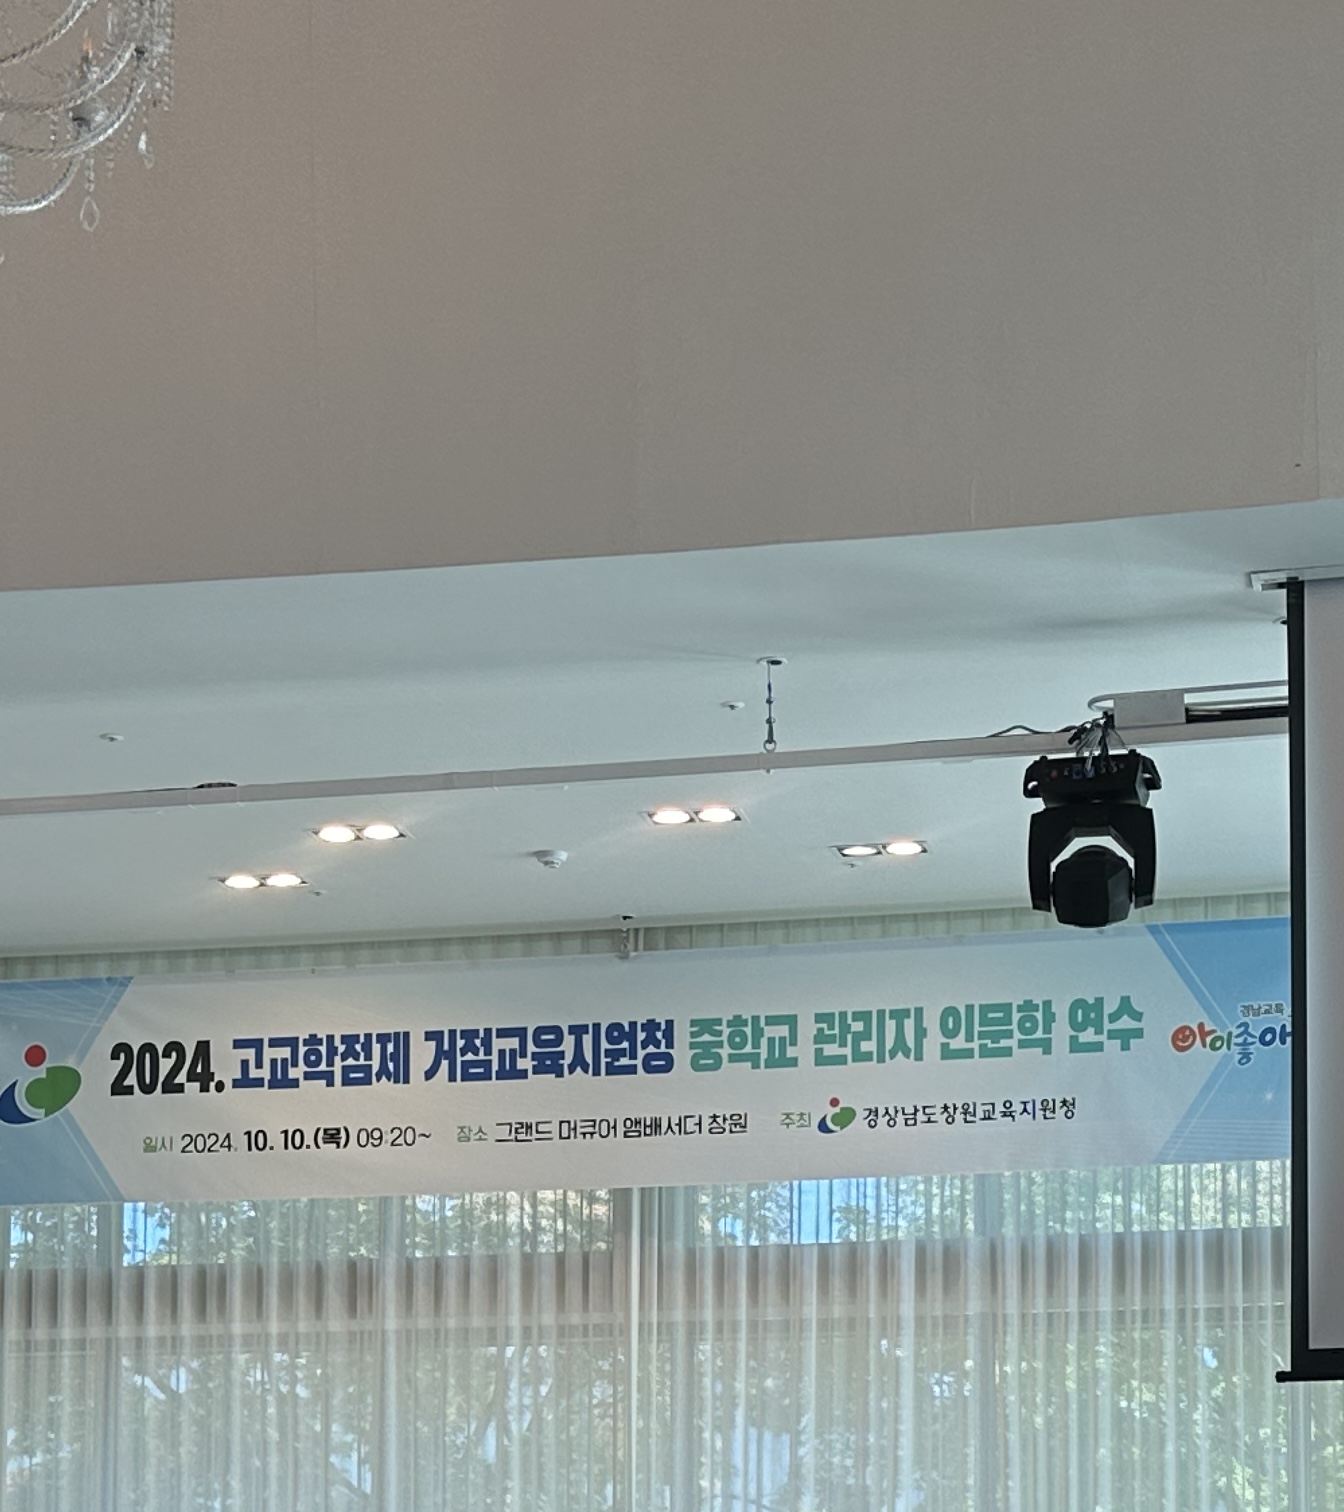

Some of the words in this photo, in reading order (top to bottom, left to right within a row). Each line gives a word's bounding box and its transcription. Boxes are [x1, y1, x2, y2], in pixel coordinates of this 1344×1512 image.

[109, 1039, 226, 1097] 2024.
[231, 1031, 411, 1090] 고교학점제
[423, 1018, 675, 1083] 거점교육지원청
[689, 1014, 799, 1073] 중학교
[813, 1005, 927, 1067] 관리자
[939, 999, 1056, 1061] 인문학
[1067, 995, 1145, 1054] 연수
[142, 1135, 174, 1154] 일시
[180, 1132, 238, 1154] 2024.
[243, 1128, 274, 1151] 10.
[456, 1124, 488, 1143] 장소
[494, 1121, 554, 1144] 그랜드
[558, 1118, 617, 1140] 머큐어
[623, 1114, 702, 1137] 앰배서더
[707, 1111, 748, 1135] 창원
[779, 1111, 812, 1129] 주최
[862, 1097, 1077, 1129] 경상남도창원교육지원청
